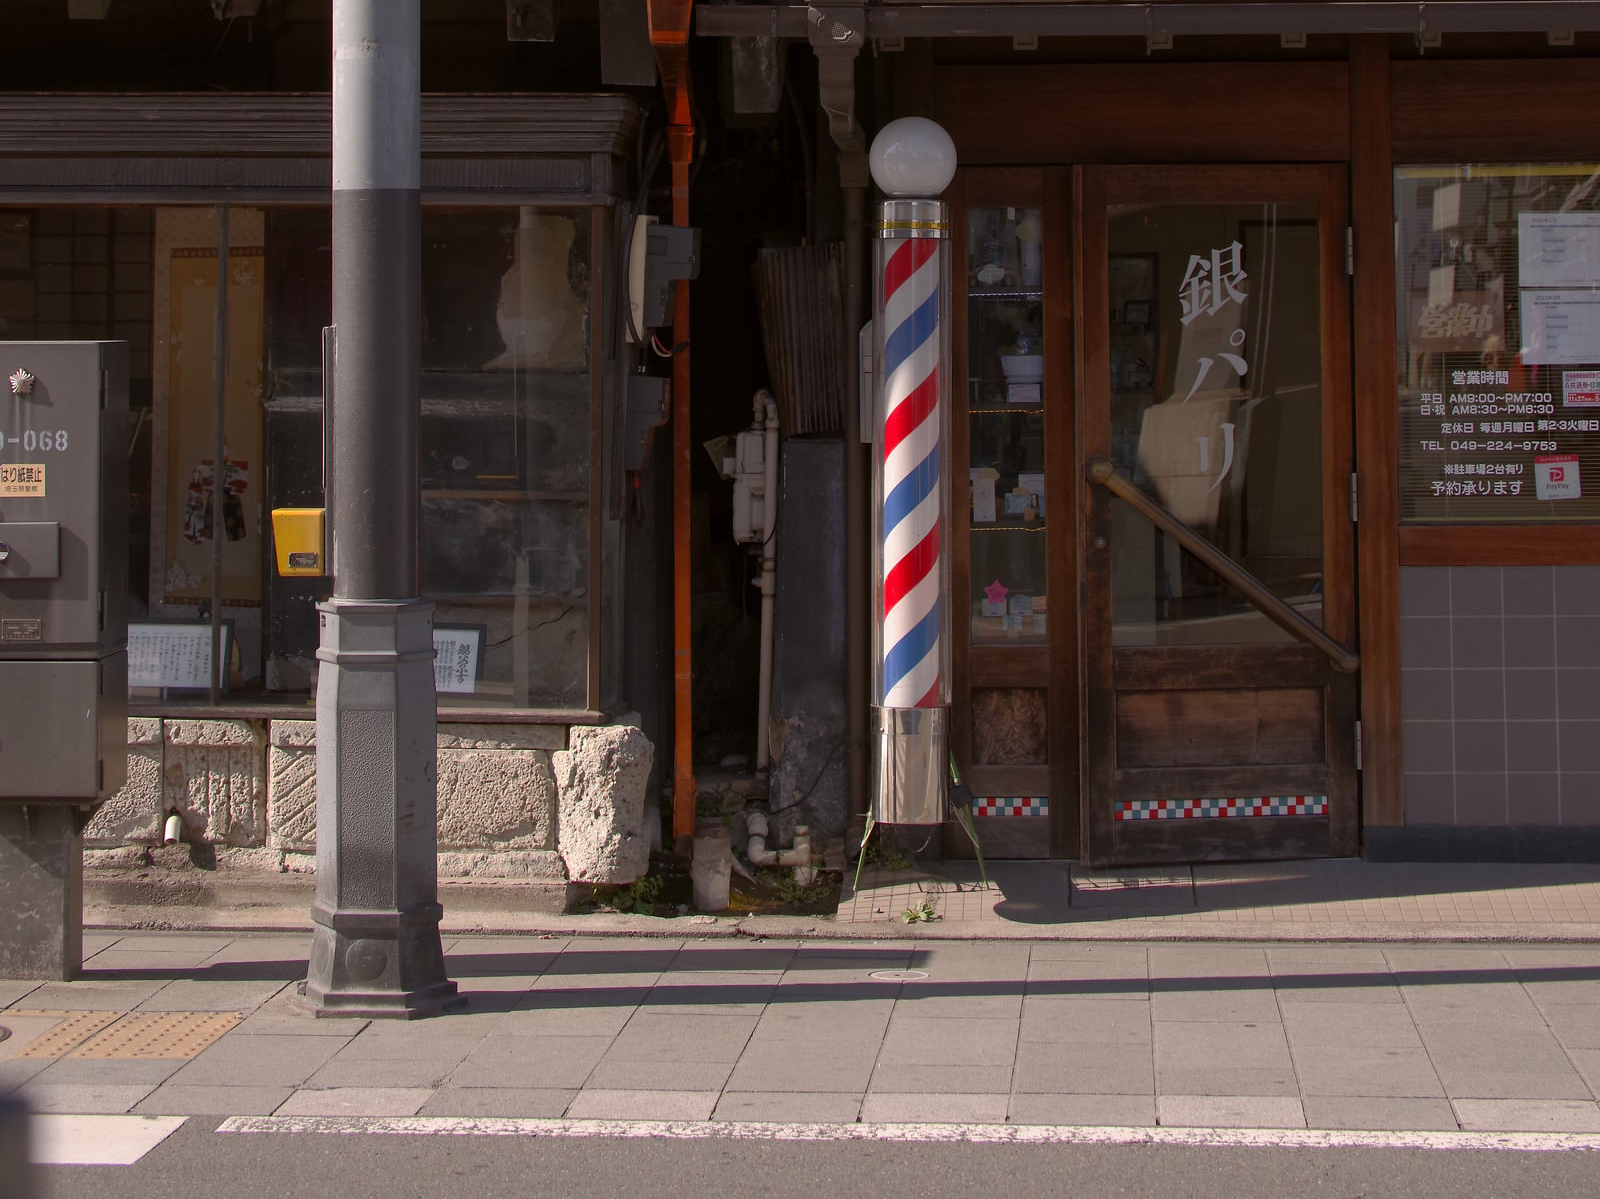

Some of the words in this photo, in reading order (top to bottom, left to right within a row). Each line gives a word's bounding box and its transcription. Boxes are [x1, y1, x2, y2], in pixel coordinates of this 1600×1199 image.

[1178, 239, 1249, 494] 銀パリ
[1451, 370, 1510, 386] 営業時間
[1420, 393, 1443, 404] 平日
[1441, 422, 1475, 434] 定休日
[1479, 421, 1535, 434] 毎週月曜日
[0, 429, 68, 452] -068
[1420, 440, 1445, 451] TEL
[1450, 440, 1558, 451] 049-224-9753
[0, 466, 43, 483] はり紙禁止
[1430, 479, 1525, 497] 予約承ります
[1546, 482, 1570, 491] PayPay
